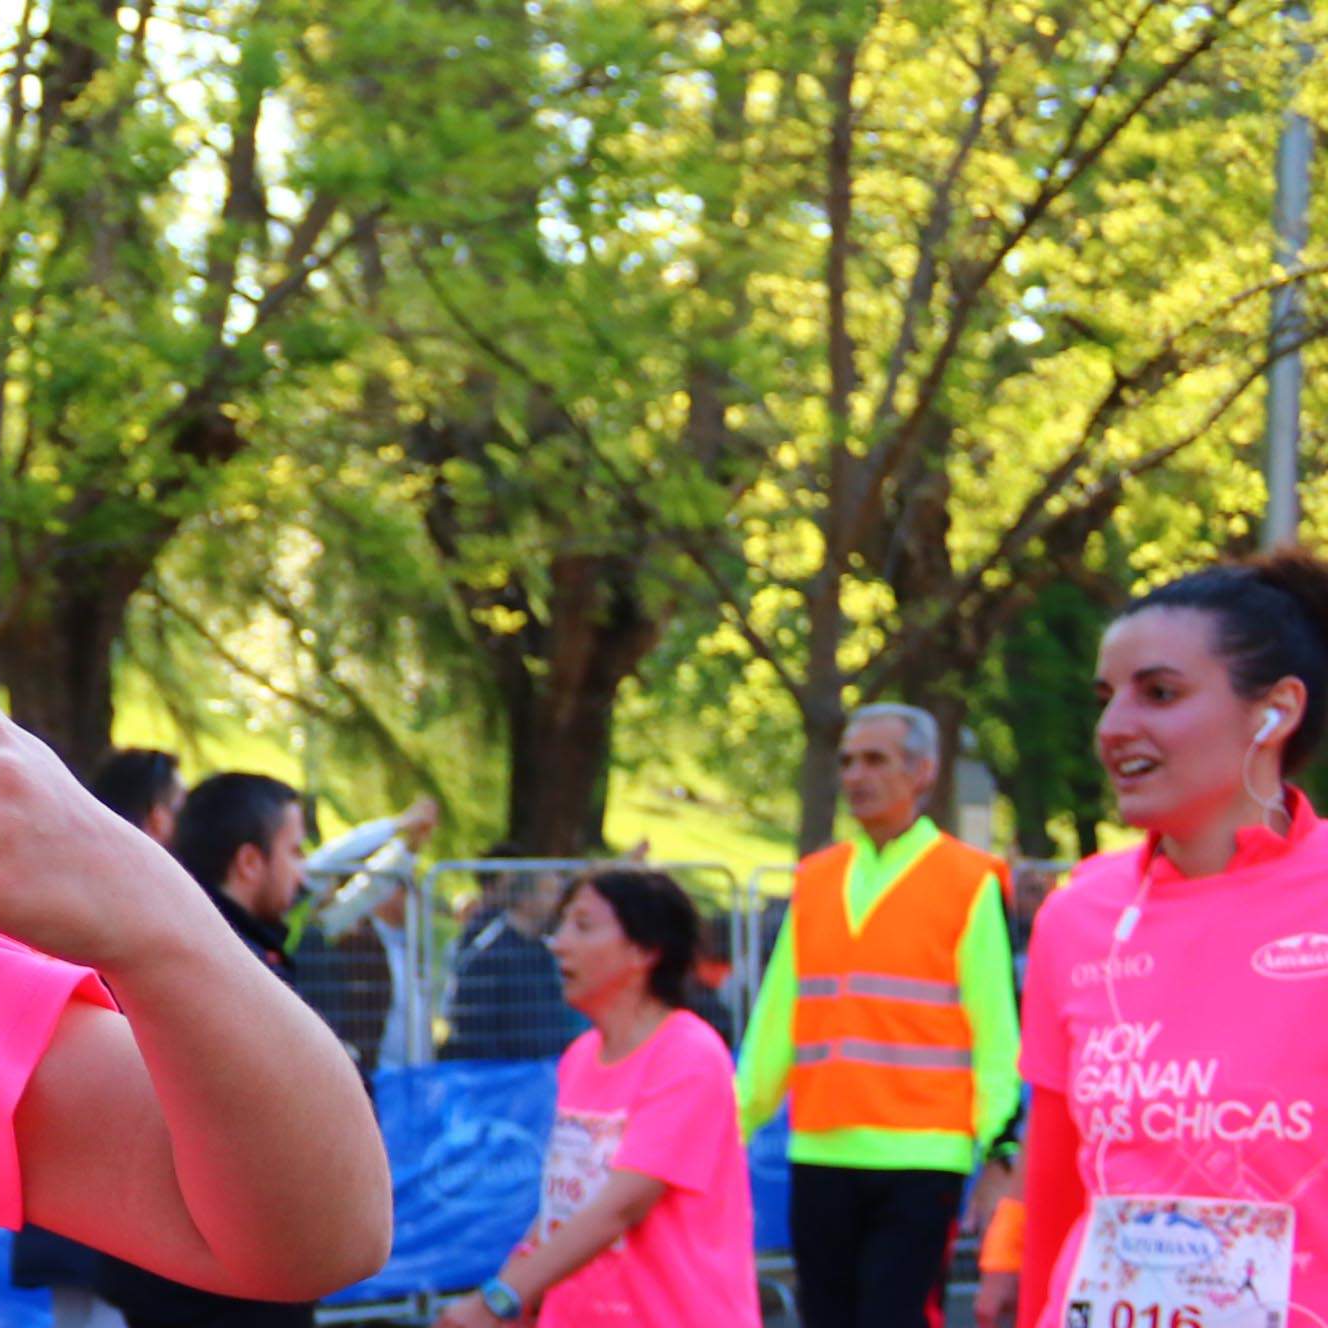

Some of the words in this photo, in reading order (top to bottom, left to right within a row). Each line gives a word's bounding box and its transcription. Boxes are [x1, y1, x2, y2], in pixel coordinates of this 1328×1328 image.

[1082, 1021, 1162, 1063] HOY
[1073, 1058, 1219, 1104] GANAN
[1087, 1104, 1135, 1142] AS
[1141, 1101, 1314, 1142] CHICAS
